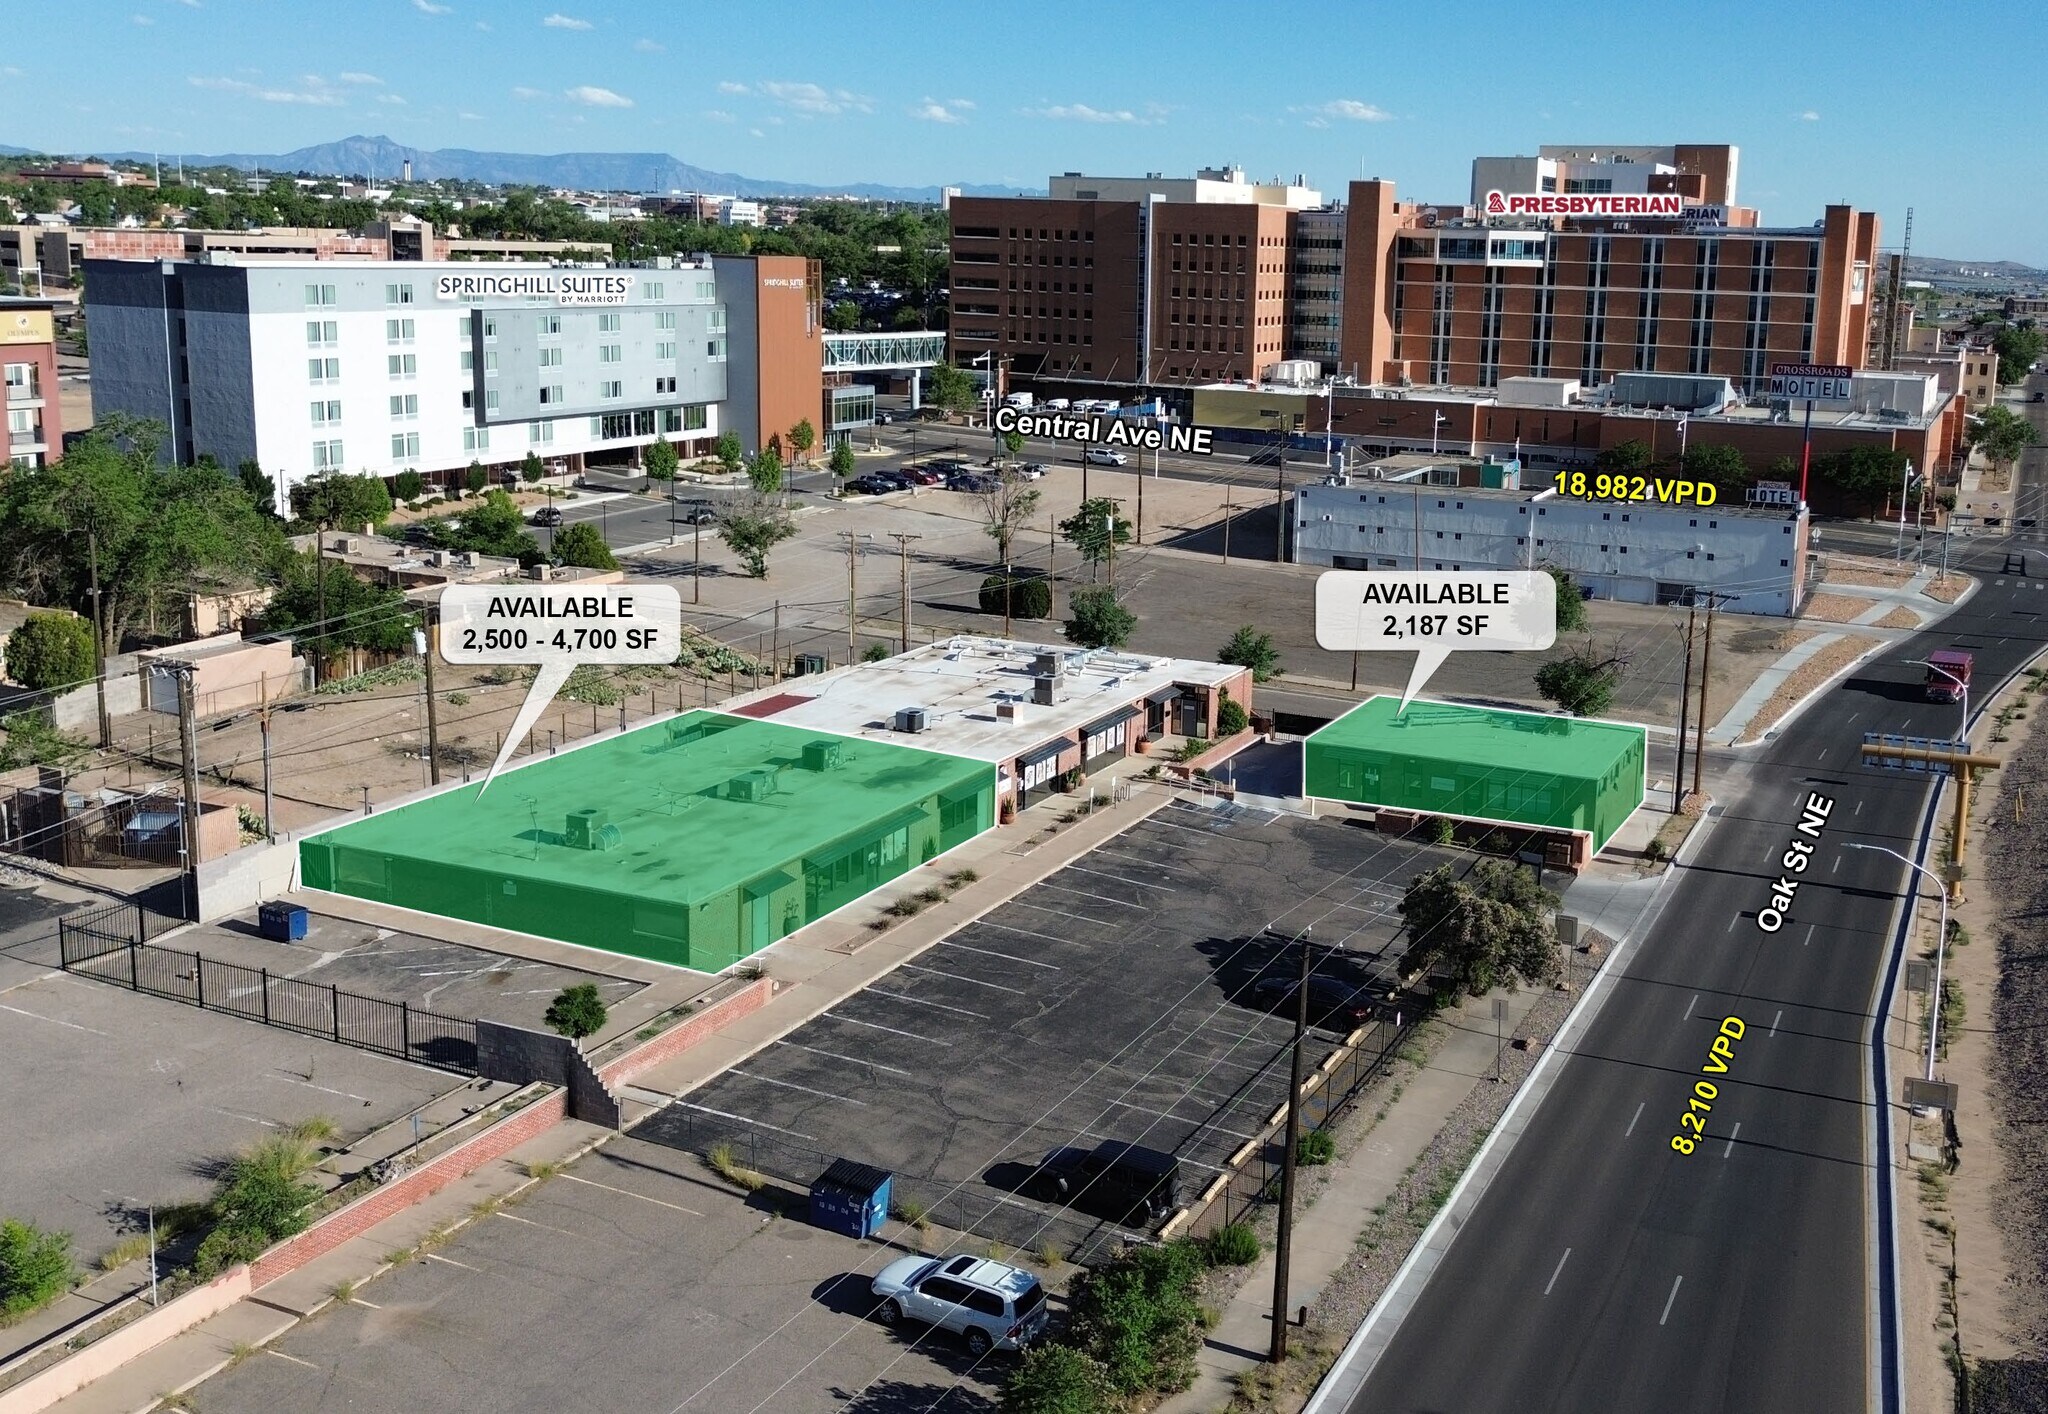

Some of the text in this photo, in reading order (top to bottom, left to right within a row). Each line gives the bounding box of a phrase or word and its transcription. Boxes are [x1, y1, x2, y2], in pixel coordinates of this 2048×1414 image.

[1775, 365, 1848, 377] CROSSROADS
[1771, 379, 1848, 397] MOTEL
[1747, 489, 1798, 503] MOTEL
